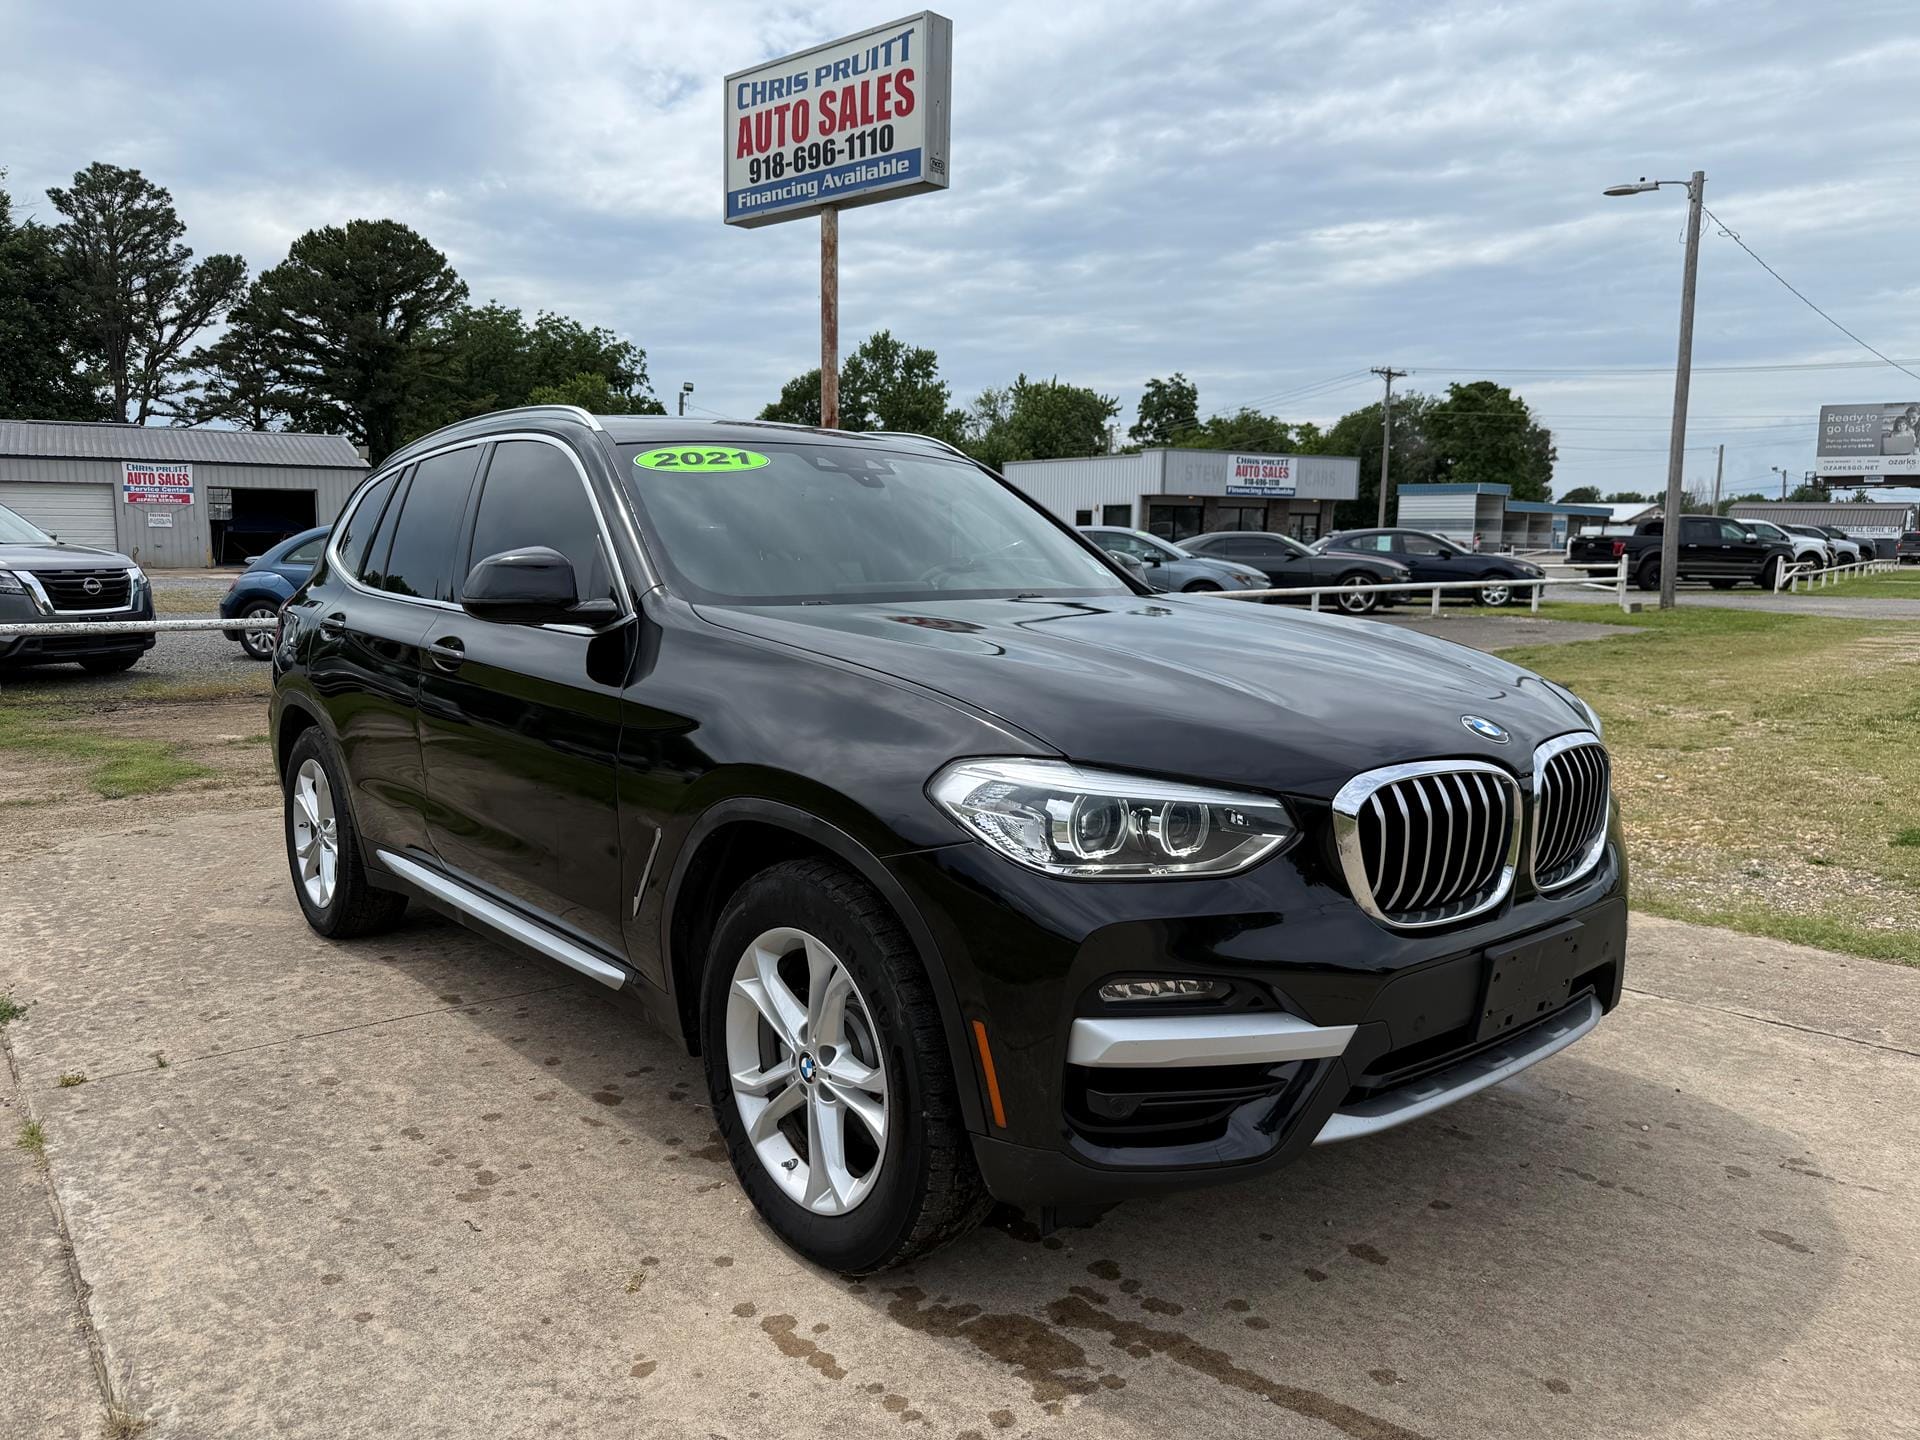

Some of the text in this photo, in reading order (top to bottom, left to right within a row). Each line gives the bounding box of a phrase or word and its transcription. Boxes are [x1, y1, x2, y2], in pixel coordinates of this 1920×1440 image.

[737, 28, 915, 110] CHRIS PRUITT
[737, 68, 915, 160] AUTO SALES
[749, 124, 894, 184] 918-696-1110
[737, 179, 819, 209] Financing
[822, 158, 909, 190] Available
[1827, 413, 1863, 423] Ready
[1826, 423, 1872, 435] go fast?
[653, 451, 751, 467] 2021
[1236, 456, 1261, 464] CHRIS
[1888, 458, 1920, 466] ozarks
[126, 463, 189, 473] CHRIS PRUITT
[1235, 465, 1290, 479] AUTO SALES
[127, 472, 190, 486] AUTO SALES
[1228, 486, 1295, 496] Financing Available
